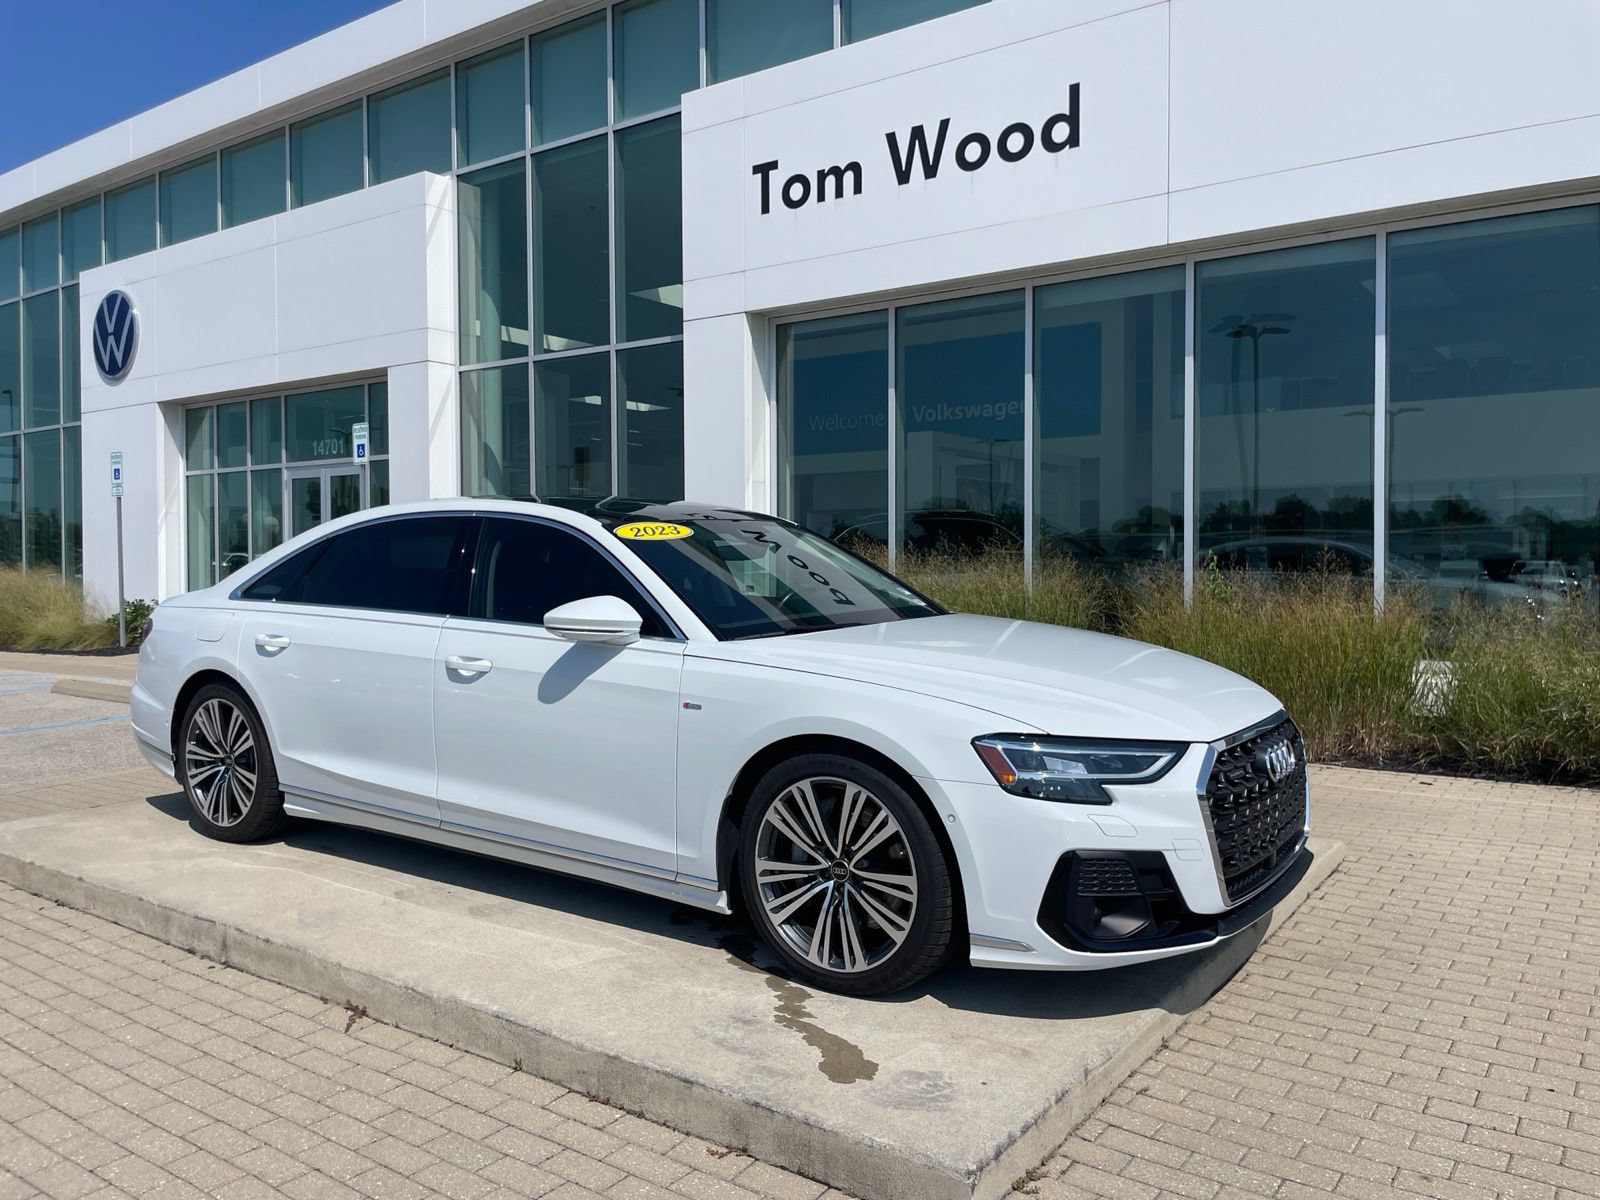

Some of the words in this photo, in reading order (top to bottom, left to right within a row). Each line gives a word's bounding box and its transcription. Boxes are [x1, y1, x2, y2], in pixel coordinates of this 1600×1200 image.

[752, 159, 863, 215] Tom
[885, 82, 1080, 186] Wood
[808, 413, 885, 432] Welcome
[312, 438, 344, 456] 14701
[630, 525, 681, 538] 2023
